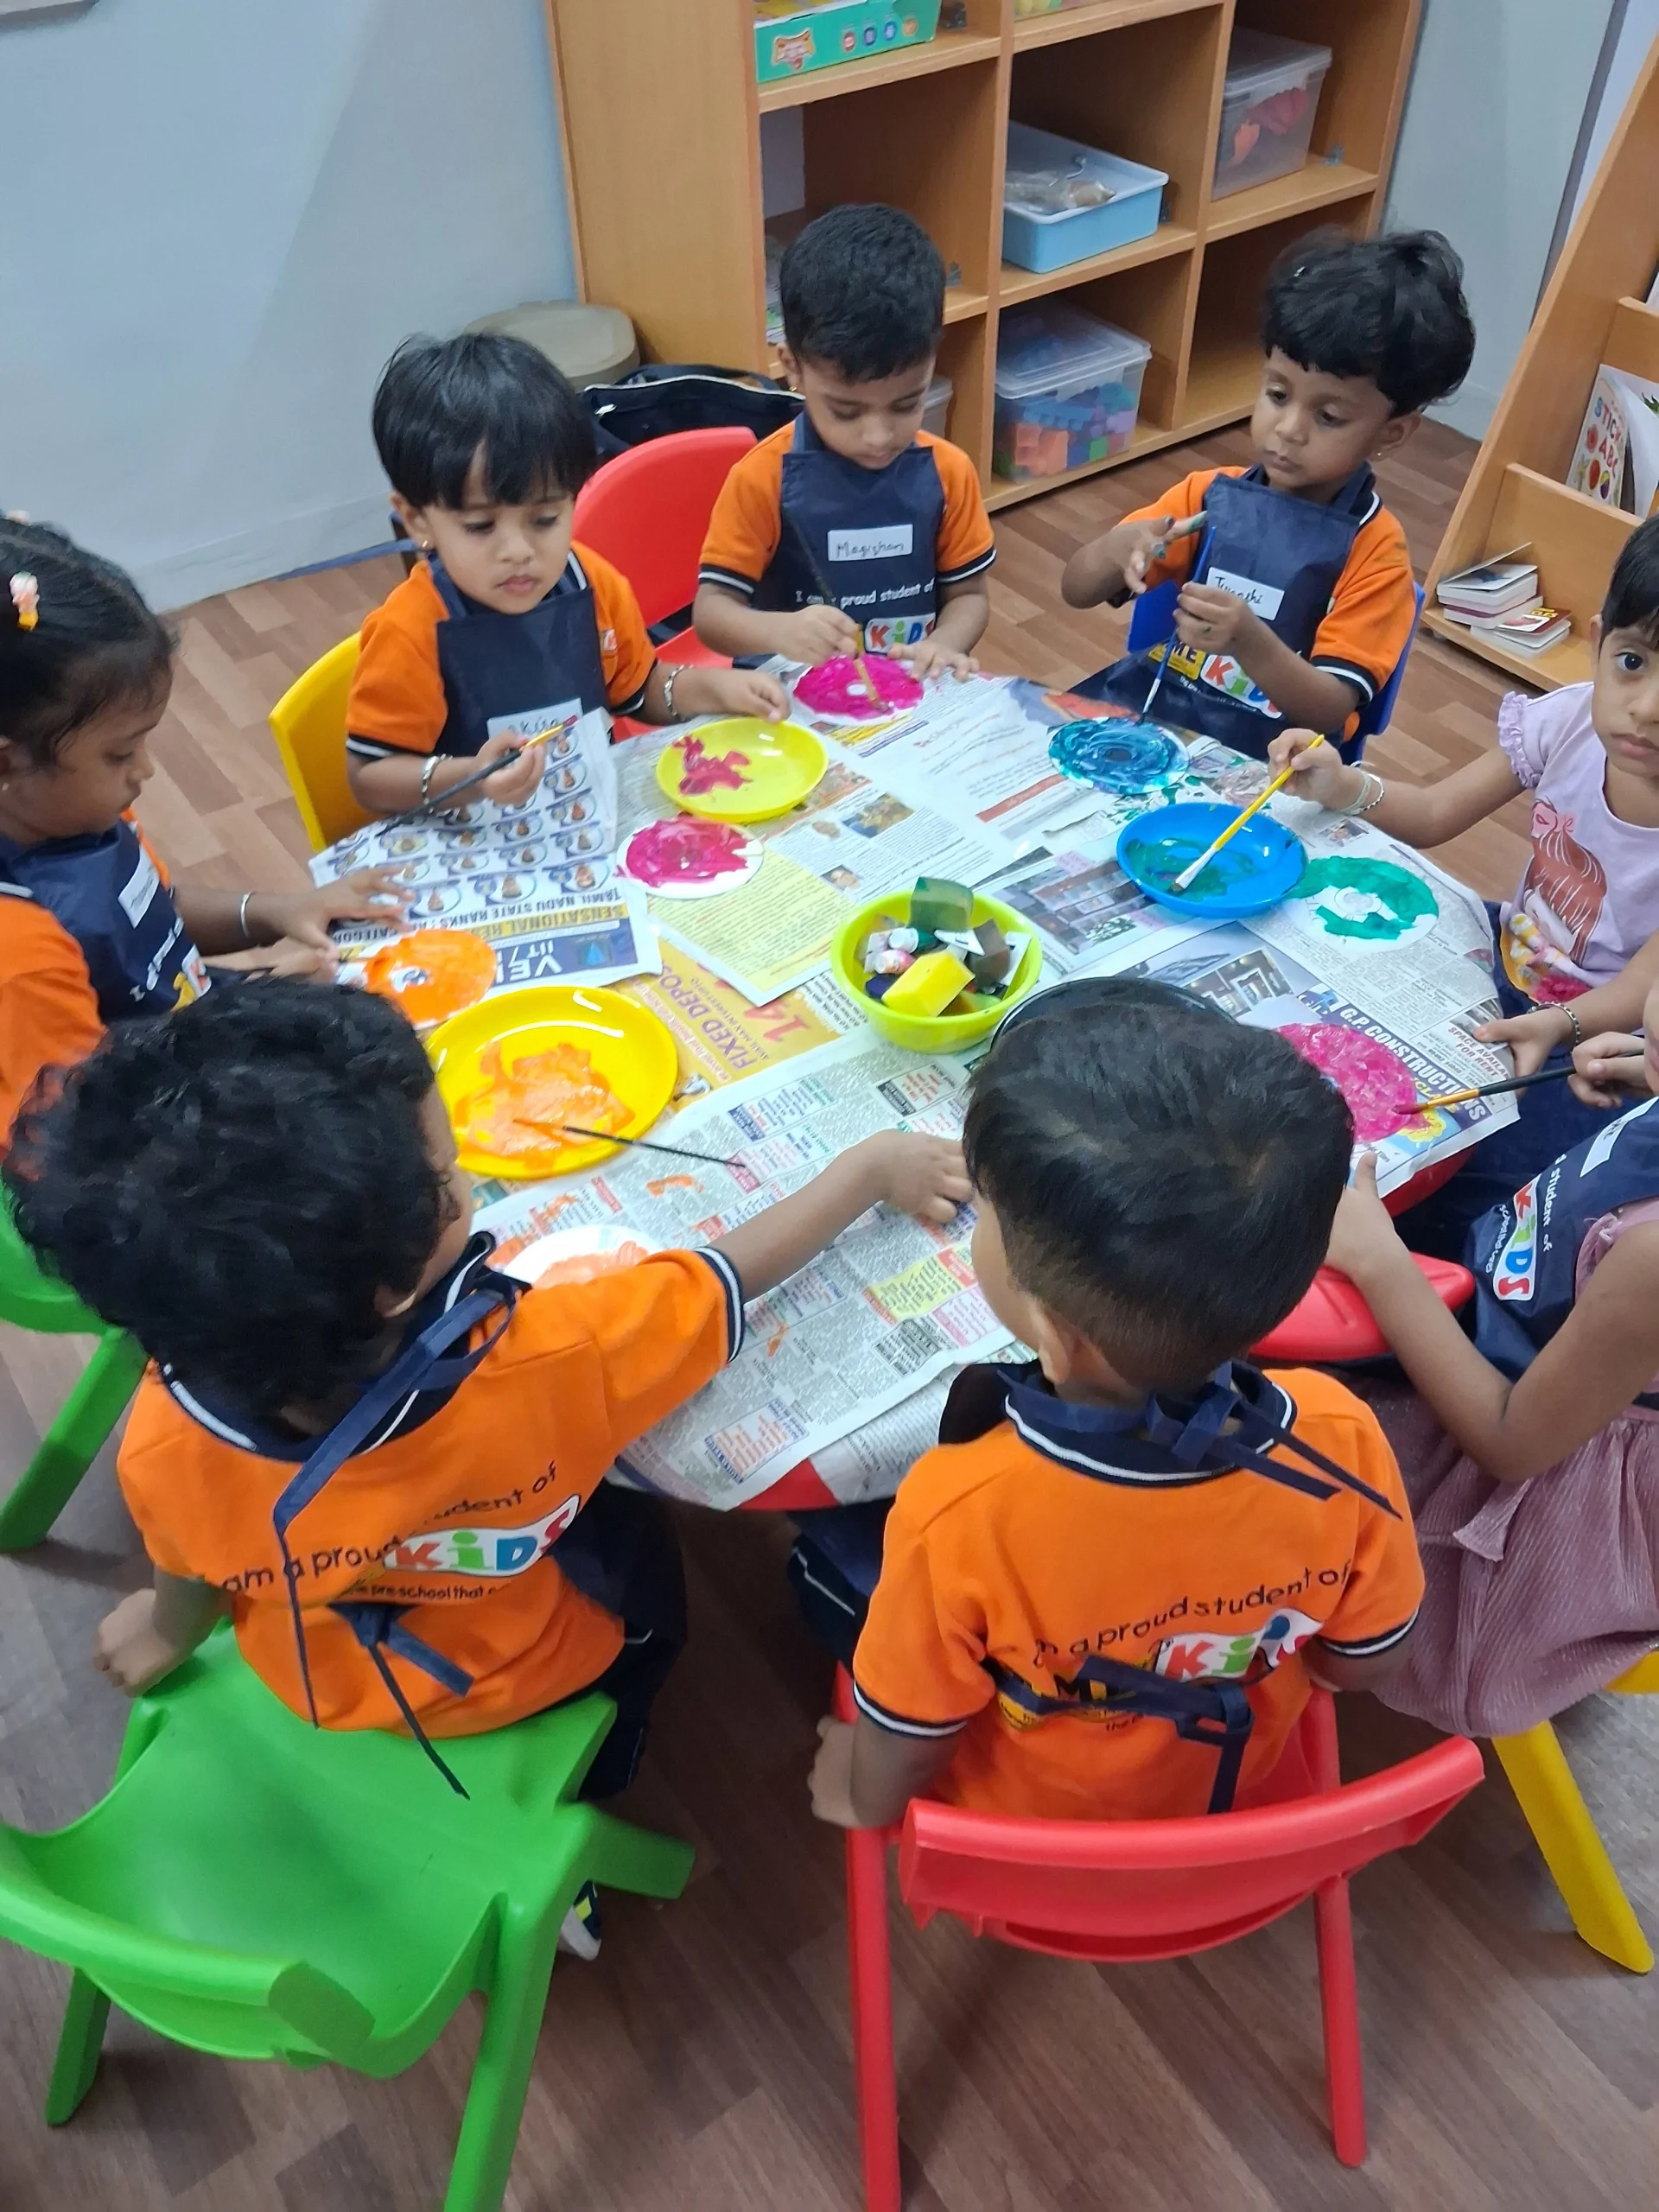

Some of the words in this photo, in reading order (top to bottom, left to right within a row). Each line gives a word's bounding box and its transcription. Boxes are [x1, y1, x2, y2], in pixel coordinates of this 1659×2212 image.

[841, 590, 876, 610] proud
[880, 583, 921, 601] student
[924, 577, 935, 593] of
[490, 903, 533, 919] STATE
[536, 896, 575, 912] NADU
[582, 890, 621, 905] TAMIL
[510, 905, 620, 934] SENSATIONAL
[698, 1016, 757, 1070] FIXED
[1447, 1027, 1479, 1049] SPACE
[1363, 1025, 1486, 1121] CONSTRUCTINS
[1455, 1043, 1477, 1058] FOR
[1474, 1057, 1499, 1077] RENT
[1543, 1166, 1562, 1227] student
[532, 1460, 557, 1494] of
[402, 1585, 451, 1599] school
[454, 1585, 485, 1599] that
[1097, 1597, 1188, 1650] proud
[1193, 1567, 1312, 1616] student
